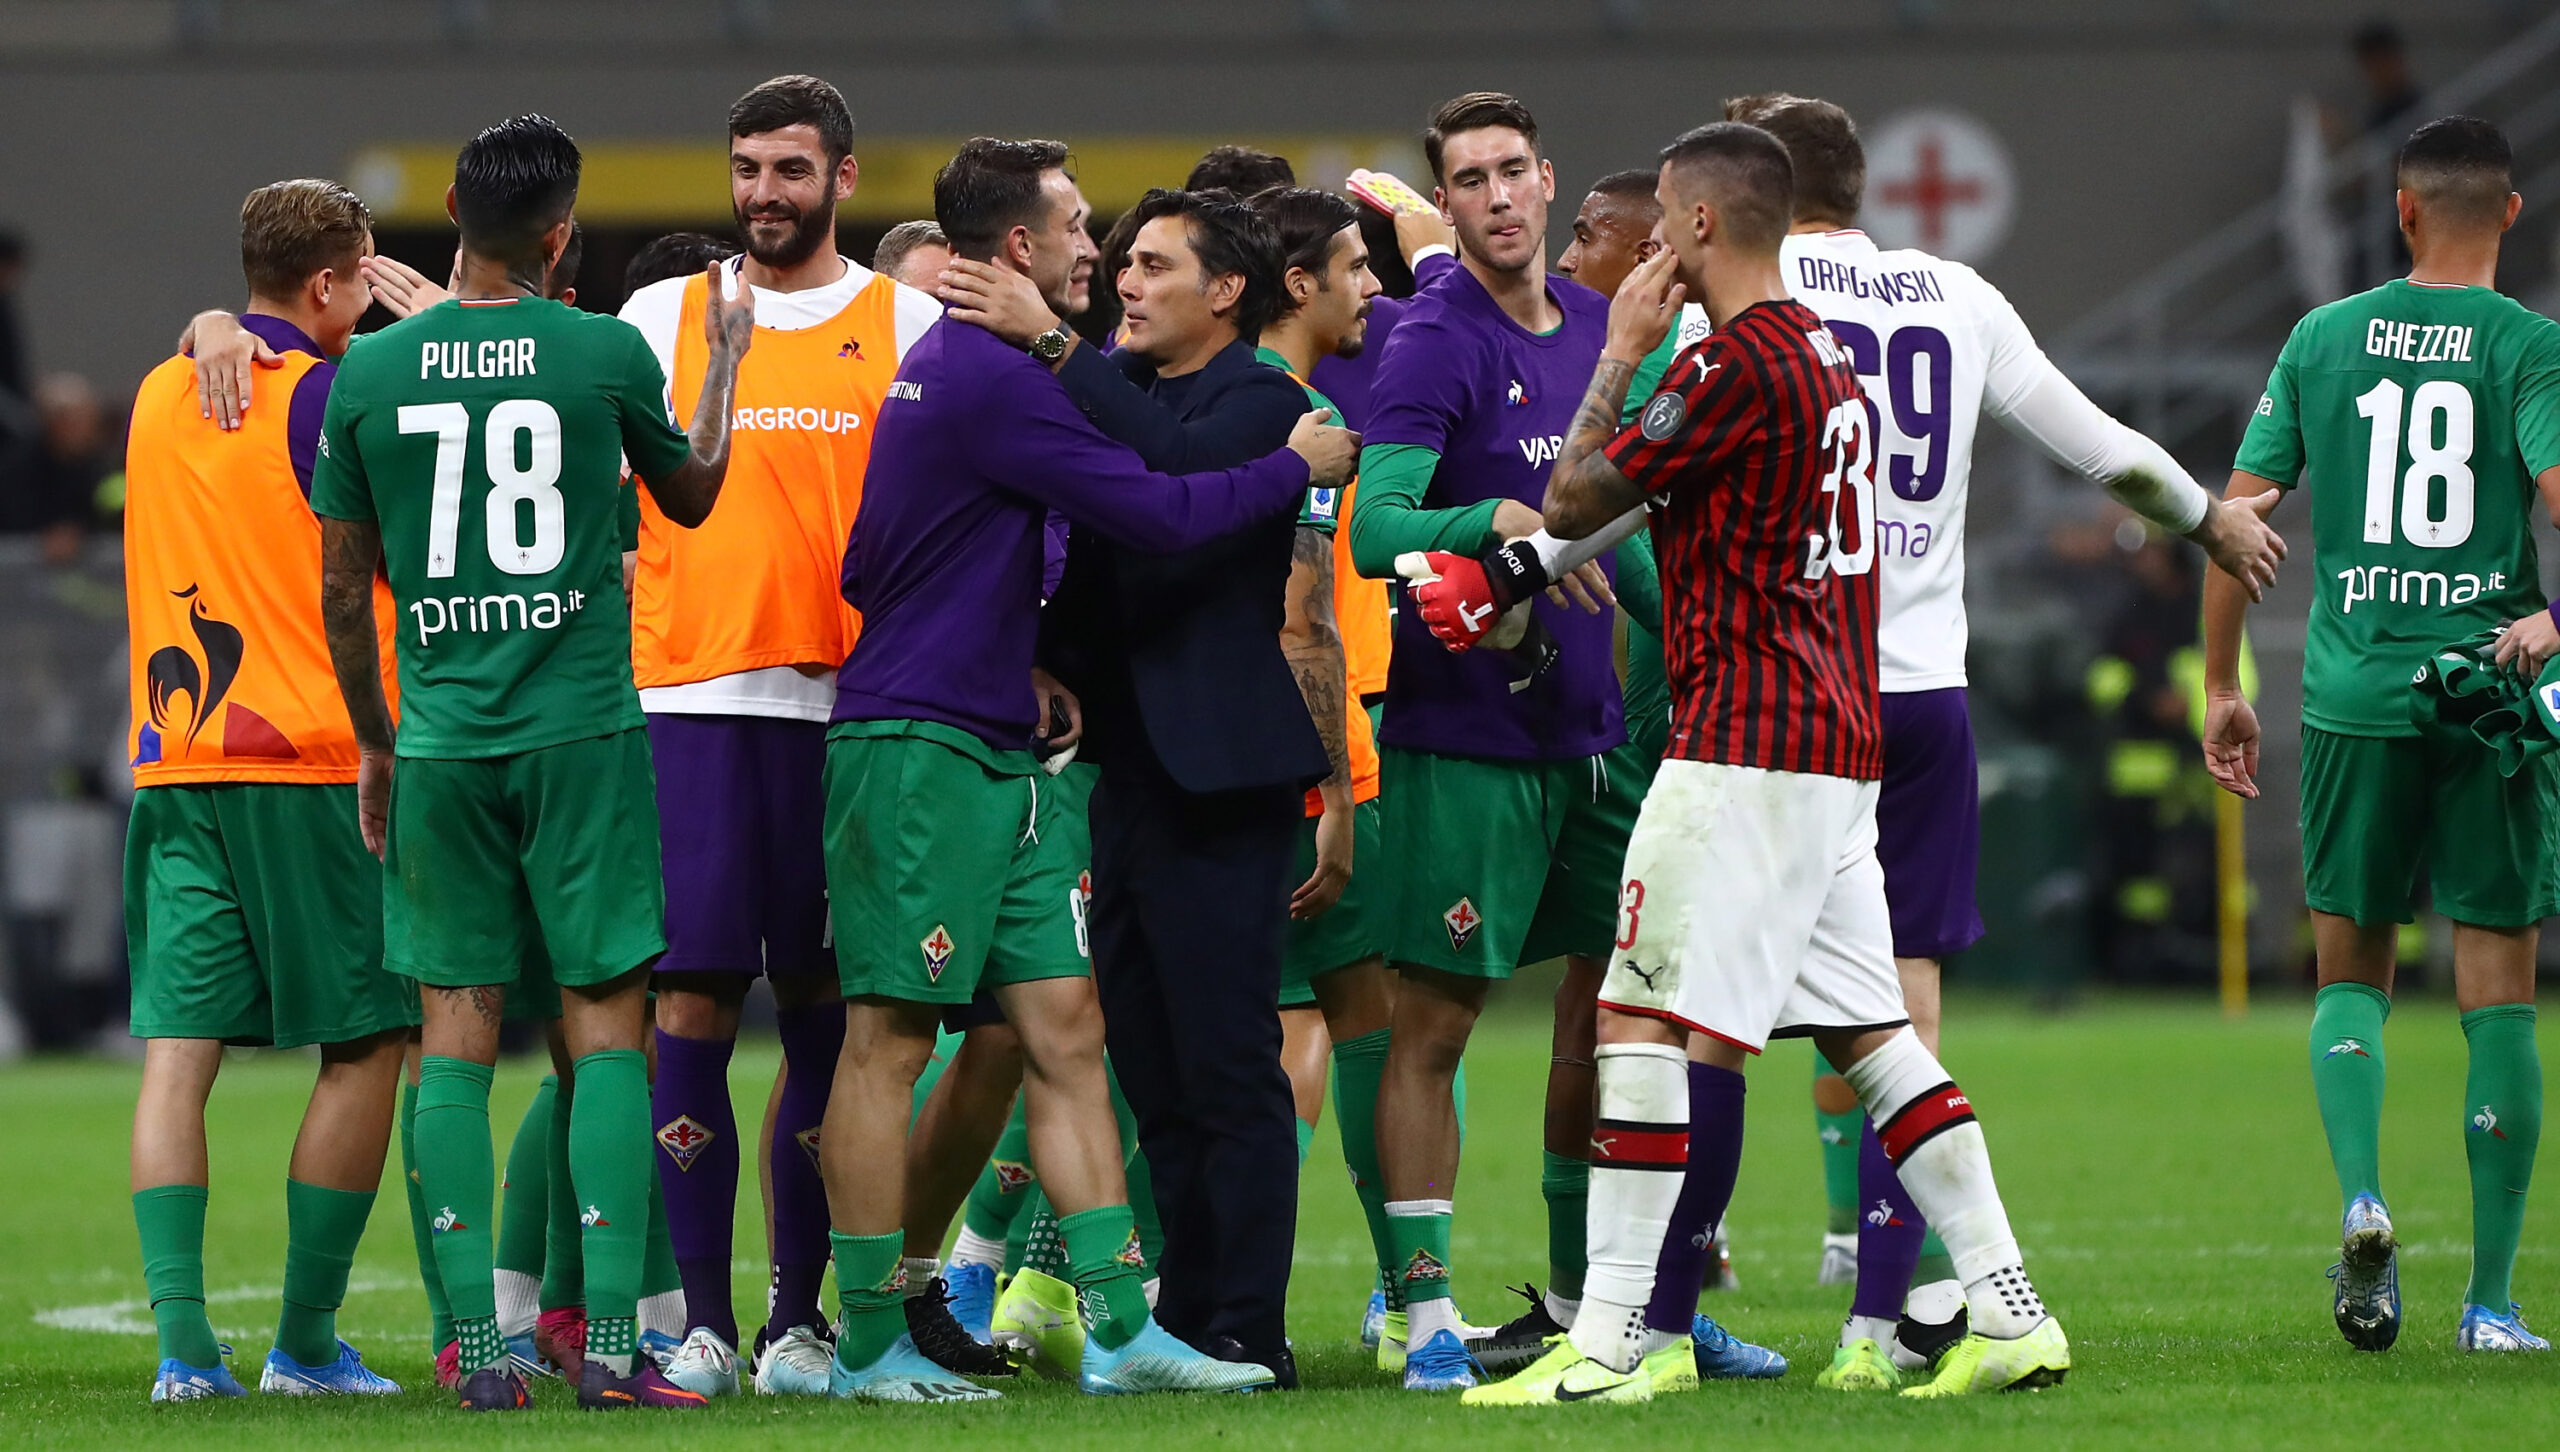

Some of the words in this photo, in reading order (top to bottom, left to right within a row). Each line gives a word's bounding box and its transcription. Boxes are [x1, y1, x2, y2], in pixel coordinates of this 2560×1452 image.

[420, 337, 537, 380] PULGAR
[2366, 318, 2473, 362] GHEZZAL
[397, 399, 565, 579] 78
[1803, 398, 1876, 580] 33
[2355, 377, 2475, 548] 18
[409, 589, 586, 646] prima.it
[2337, 565, 2507, 614] prima.it
[1069, 888, 1090, 958] 8
